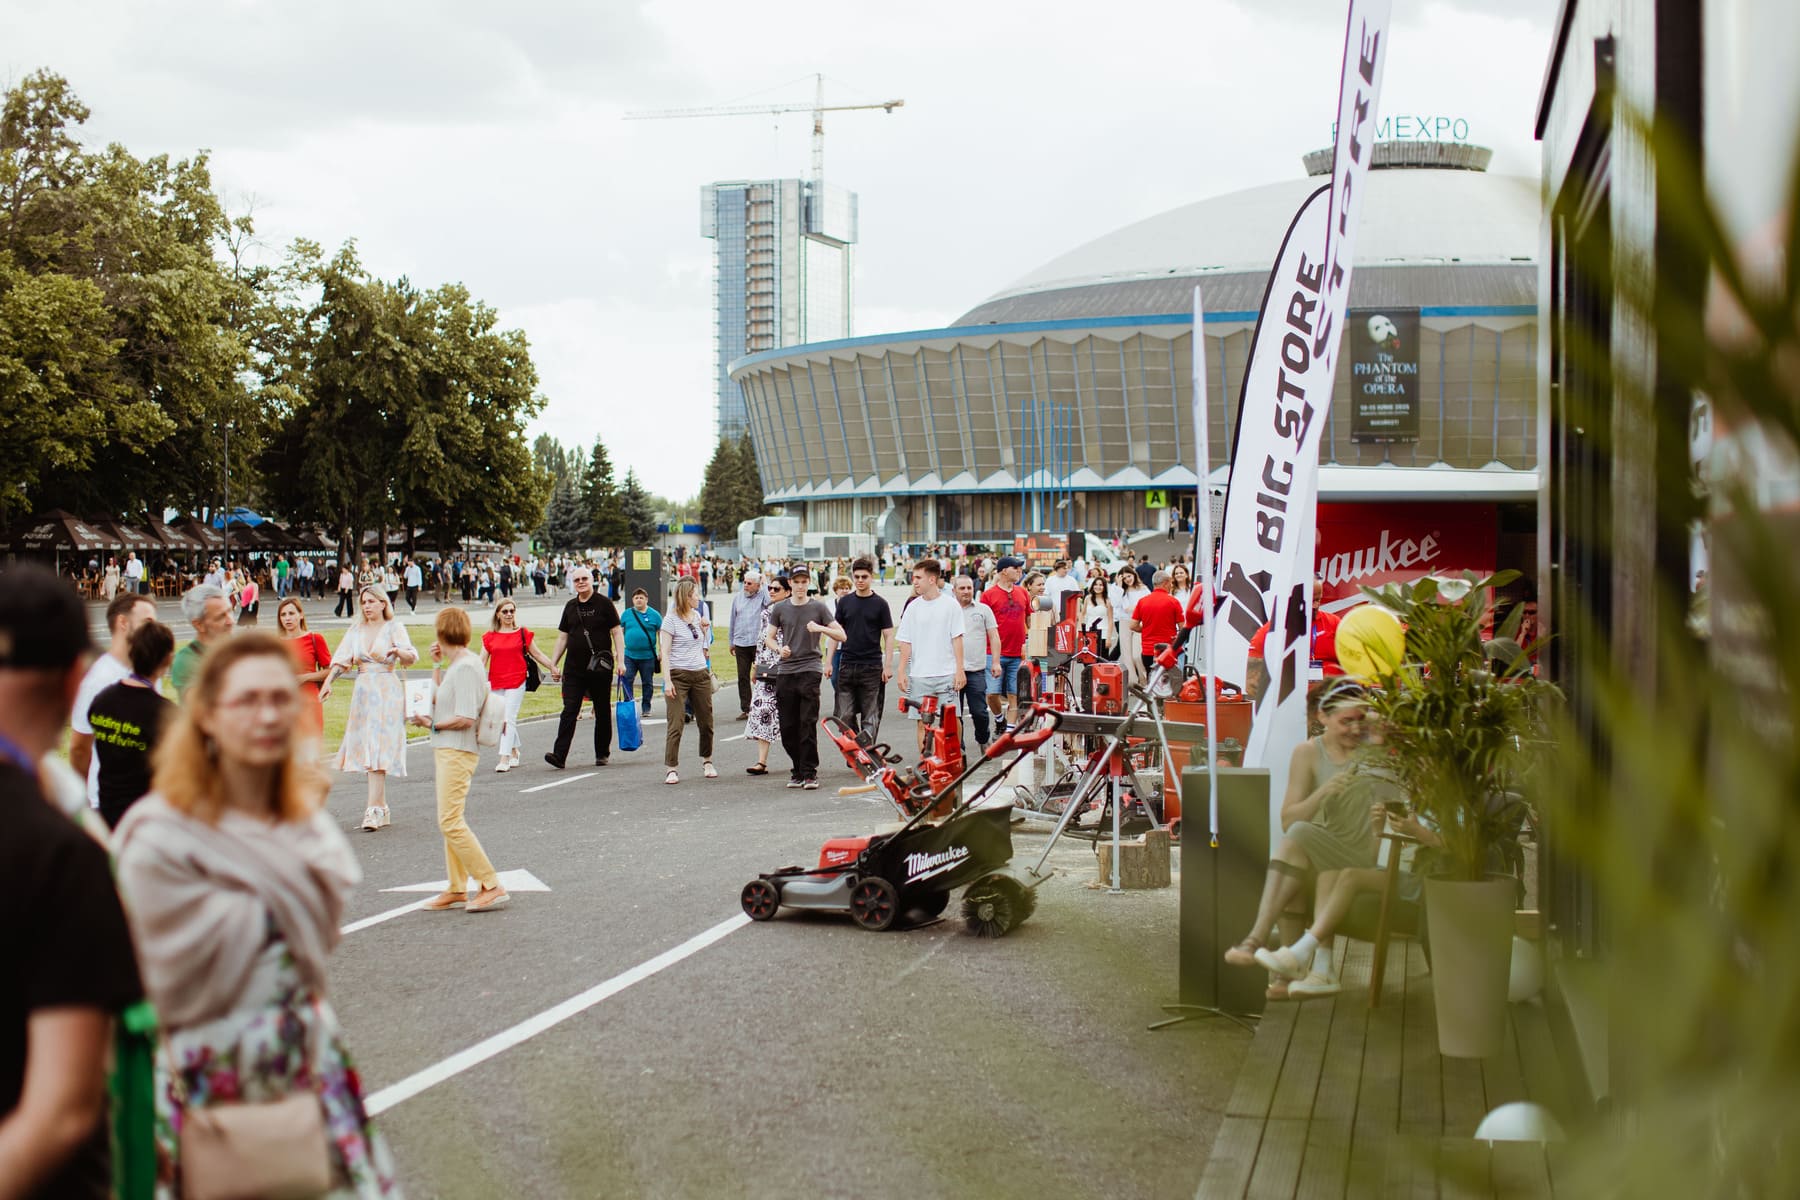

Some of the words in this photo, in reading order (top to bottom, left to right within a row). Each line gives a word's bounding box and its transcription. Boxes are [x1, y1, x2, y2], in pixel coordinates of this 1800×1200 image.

[1332, 116, 1469, 144] MEXPO
[1274, 251, 1325, 438] STORE
[1354, 362, 1417, 375] PHANTOM
[1362, 383, 1406, 395] OPERA
[1151, 491, 1161, 504] A
[1256, 454, 1294, 553] BIG
[122, 722, 141, 735] the
[903, 846, 969, 877] Milwaukee
